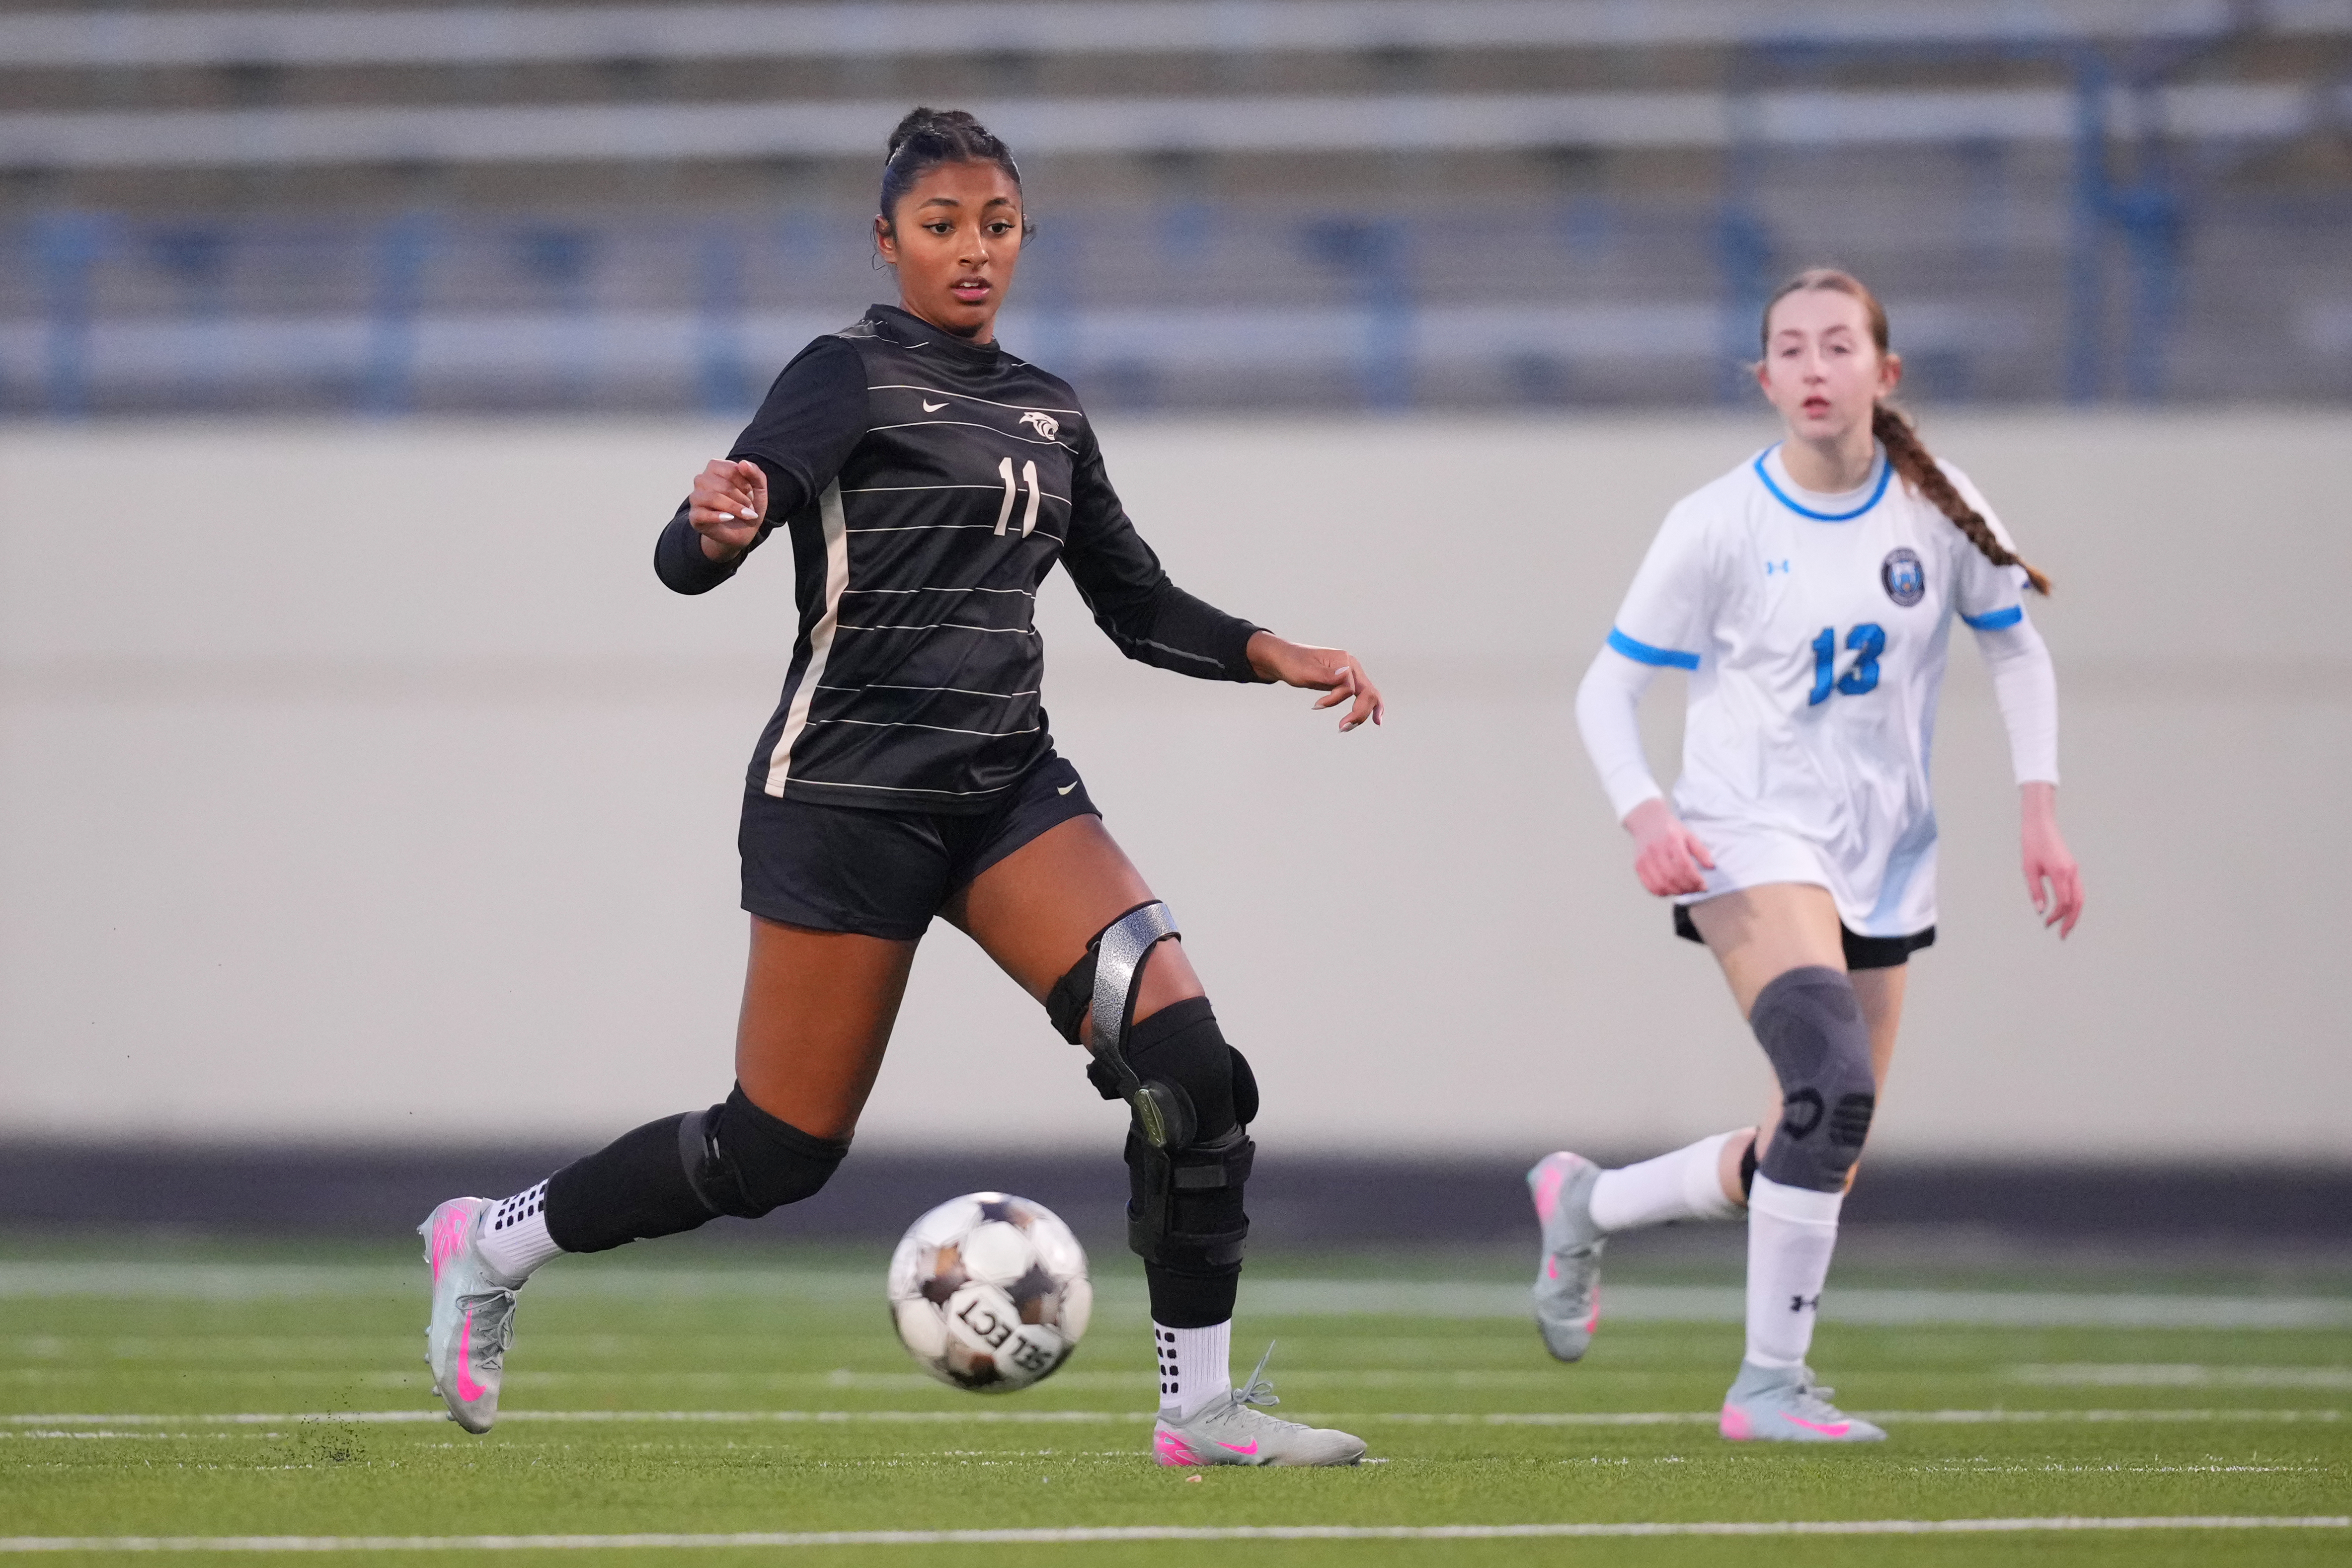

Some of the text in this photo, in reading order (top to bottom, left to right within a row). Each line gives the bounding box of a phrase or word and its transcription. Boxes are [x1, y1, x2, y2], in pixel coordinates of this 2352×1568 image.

[994, 457, 1040, 539] 11
[1809, 623, 1886, 706] 13
[957, 1300, 1054, 1371] SELECT
